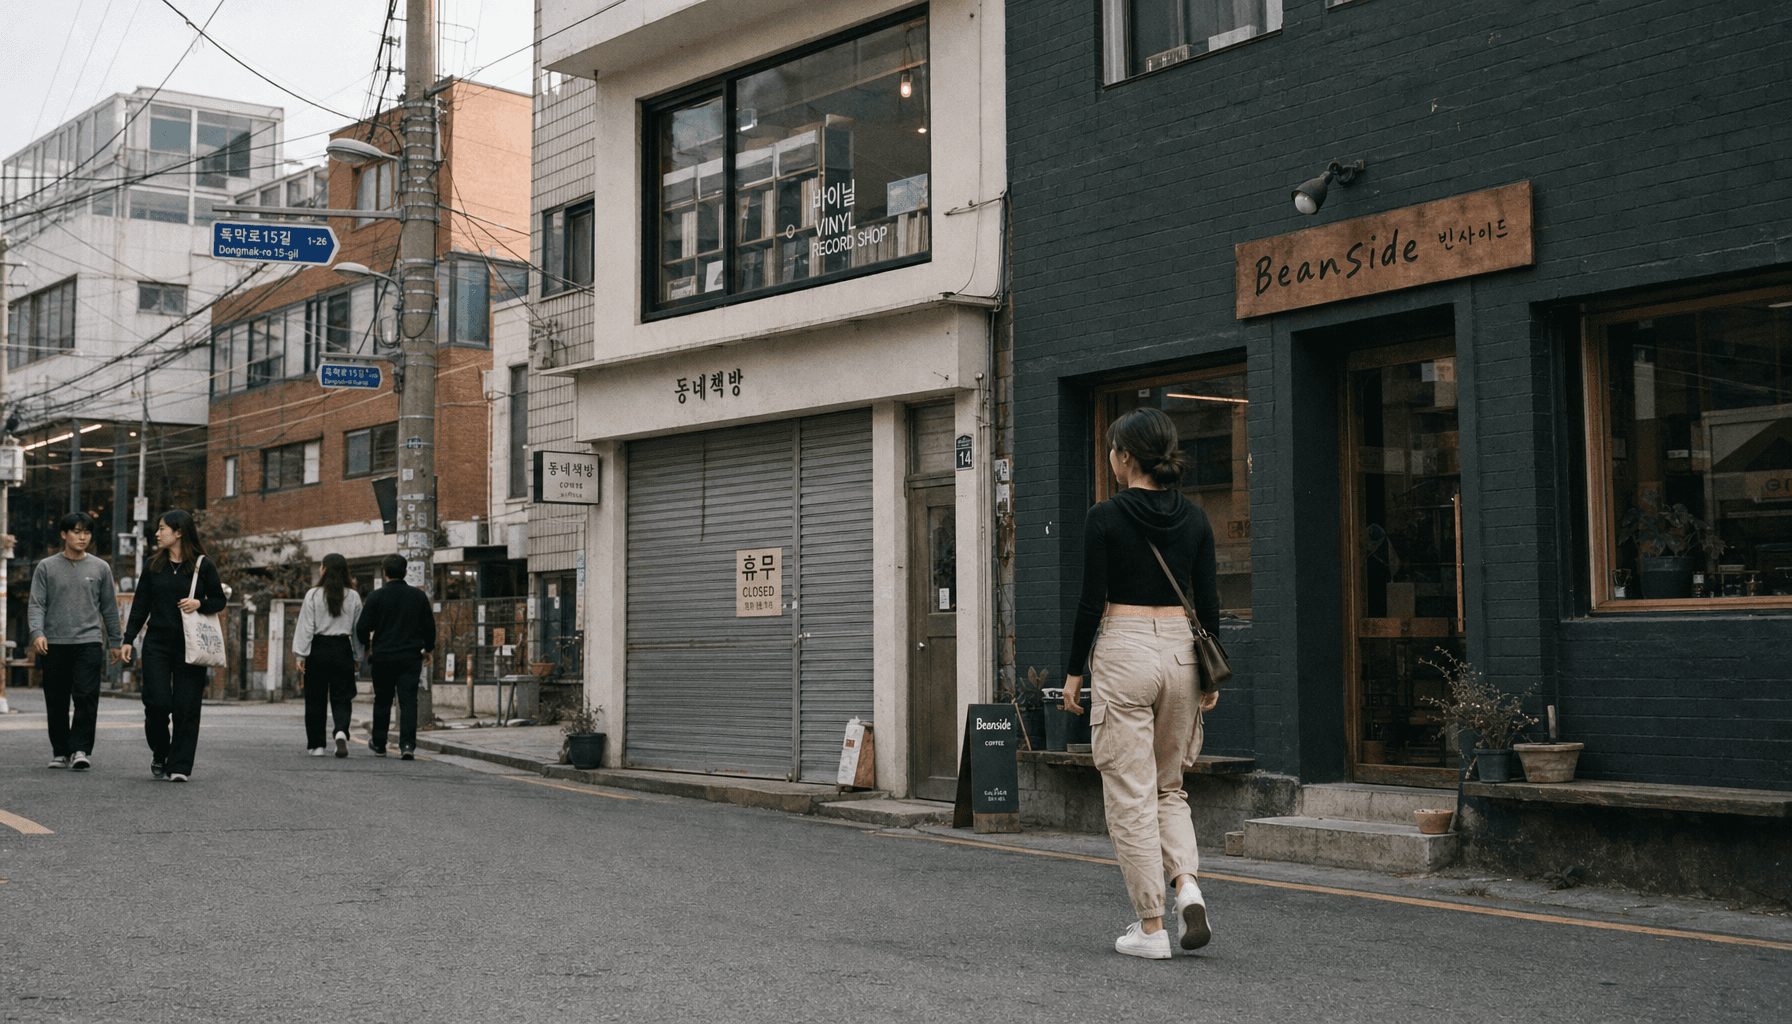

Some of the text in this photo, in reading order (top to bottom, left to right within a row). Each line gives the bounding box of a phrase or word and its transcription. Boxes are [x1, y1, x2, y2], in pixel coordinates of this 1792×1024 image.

[812, 179, 855, 212] 바이닐
[815, 211, 856, 237] VINYL
[1437, 219, 1509, 251] 빈사이드
[219, 245, 272, 257] Dongmak-ro
[307, 236, 328, 246] 1-26
[812, 226, 888, 258] RECORD SHOP
[674, 368, 744, 405] 동네책방
[959, 450, 972, 466] 14
[742, 554, 775, 581] 휴무
[742, 586, 775, 598] CLOSED
[976, 717, 1011, 730] Beanside
